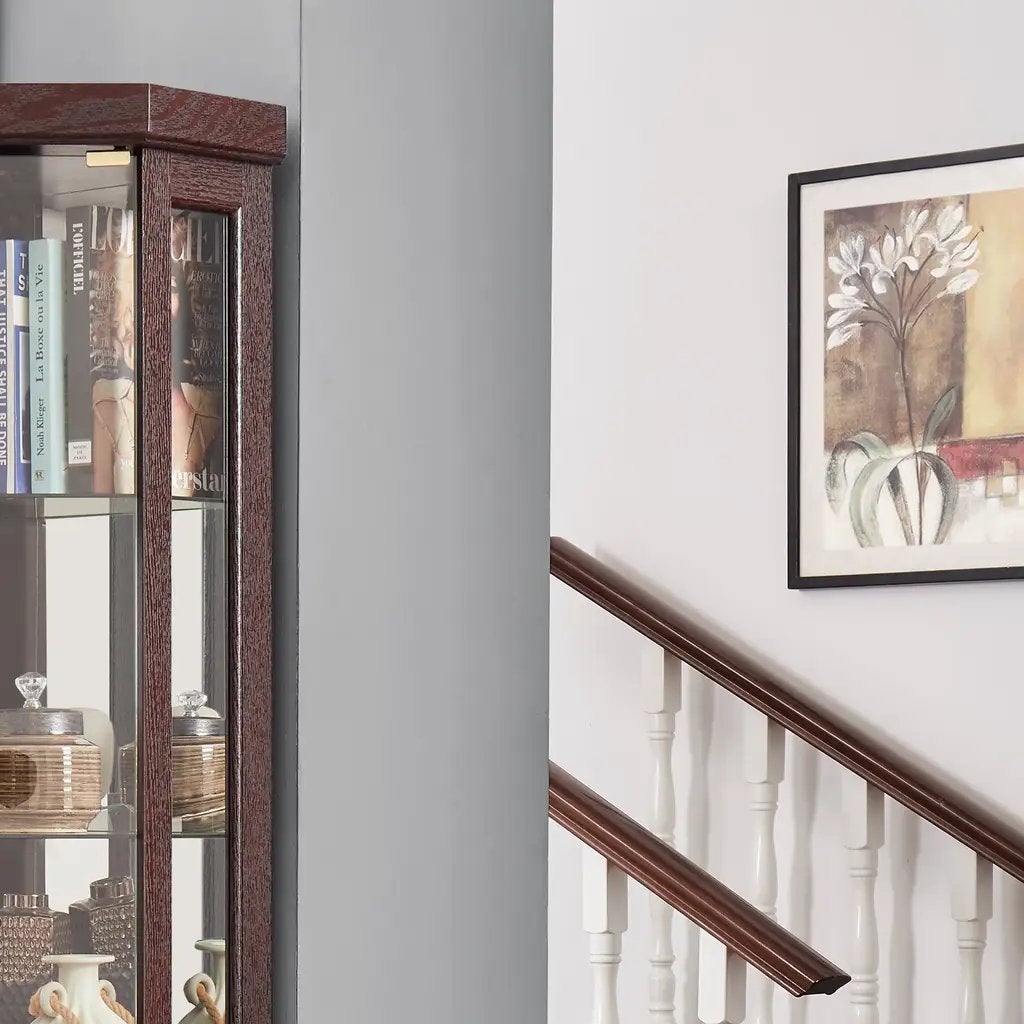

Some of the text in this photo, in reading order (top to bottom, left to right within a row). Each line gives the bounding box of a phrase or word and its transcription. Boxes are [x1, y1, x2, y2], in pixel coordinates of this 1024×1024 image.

[72, 222, 84, 295] L'OFFICIEL
[35, 264, 44, 383] La Boxe ou la Vie
[36, 398, 46, 429] Klieger
